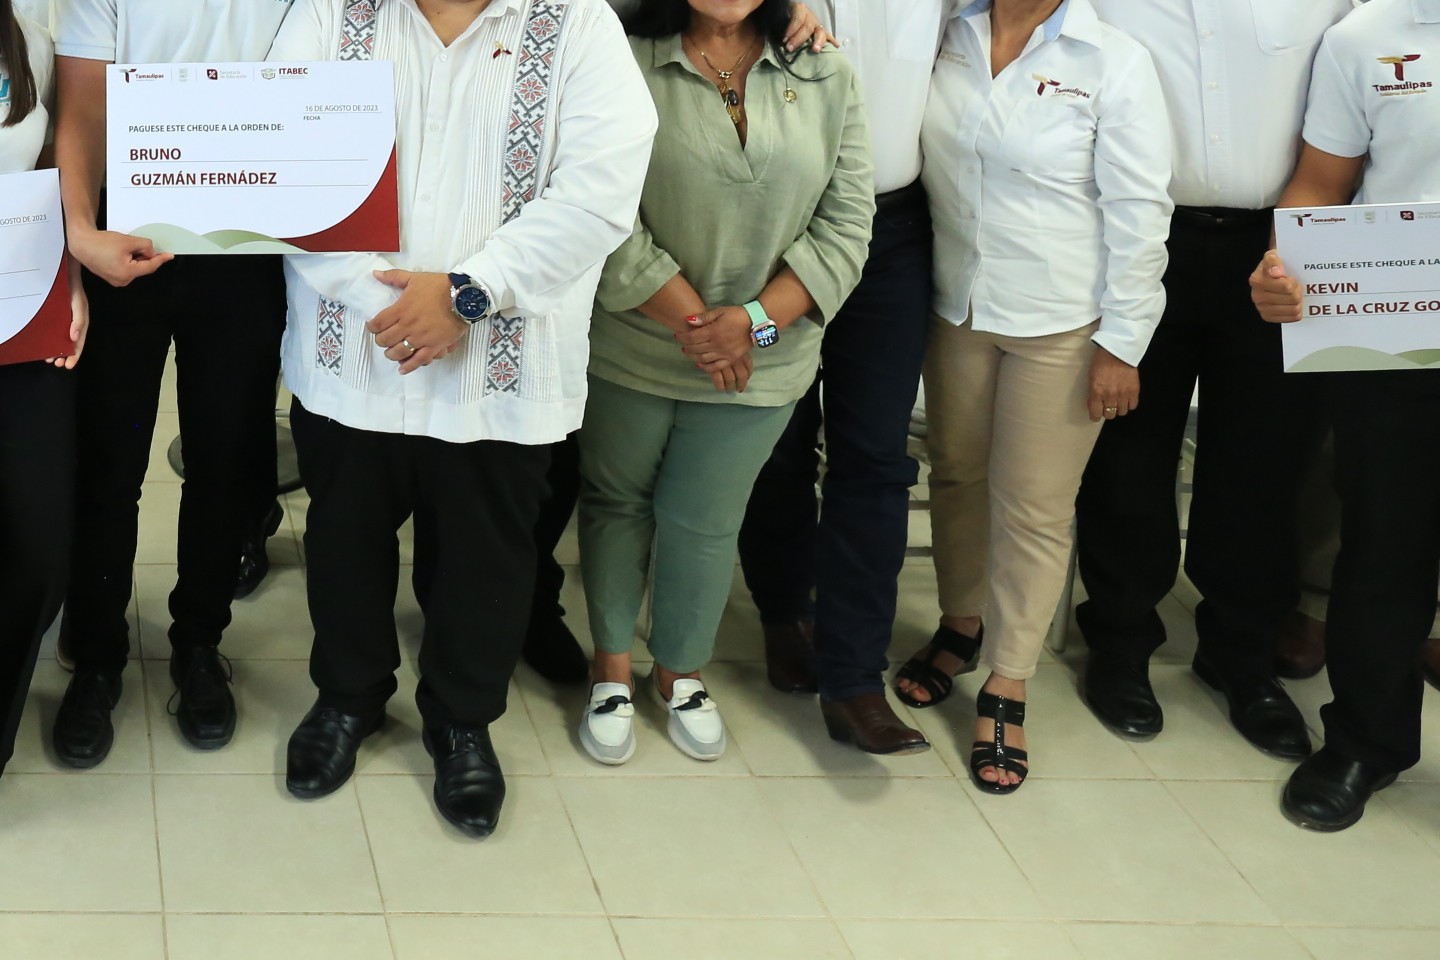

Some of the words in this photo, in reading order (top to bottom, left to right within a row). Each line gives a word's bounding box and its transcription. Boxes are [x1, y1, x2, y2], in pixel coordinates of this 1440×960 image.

[1372, 81, 1432, 92] Tamaulipas
[186, 124, 219, 132] CHEQUE
[130, 148, 181, 161] BRUNO
[131, 170, 196, 186] GUZMÁN
[200, 170, 277, 185] FERNÁDEZ
[1304, 262, 1348, 270] PAGUESE
[1375, 259, 1416, 268] CHEQUE
[1306, 282, 1358, 294] KEVIN
[1309, 305, 1331, 316] DE
[1336, 304, 1358, 314] LA
[1362, 302, 1410, 314] CRUZ
